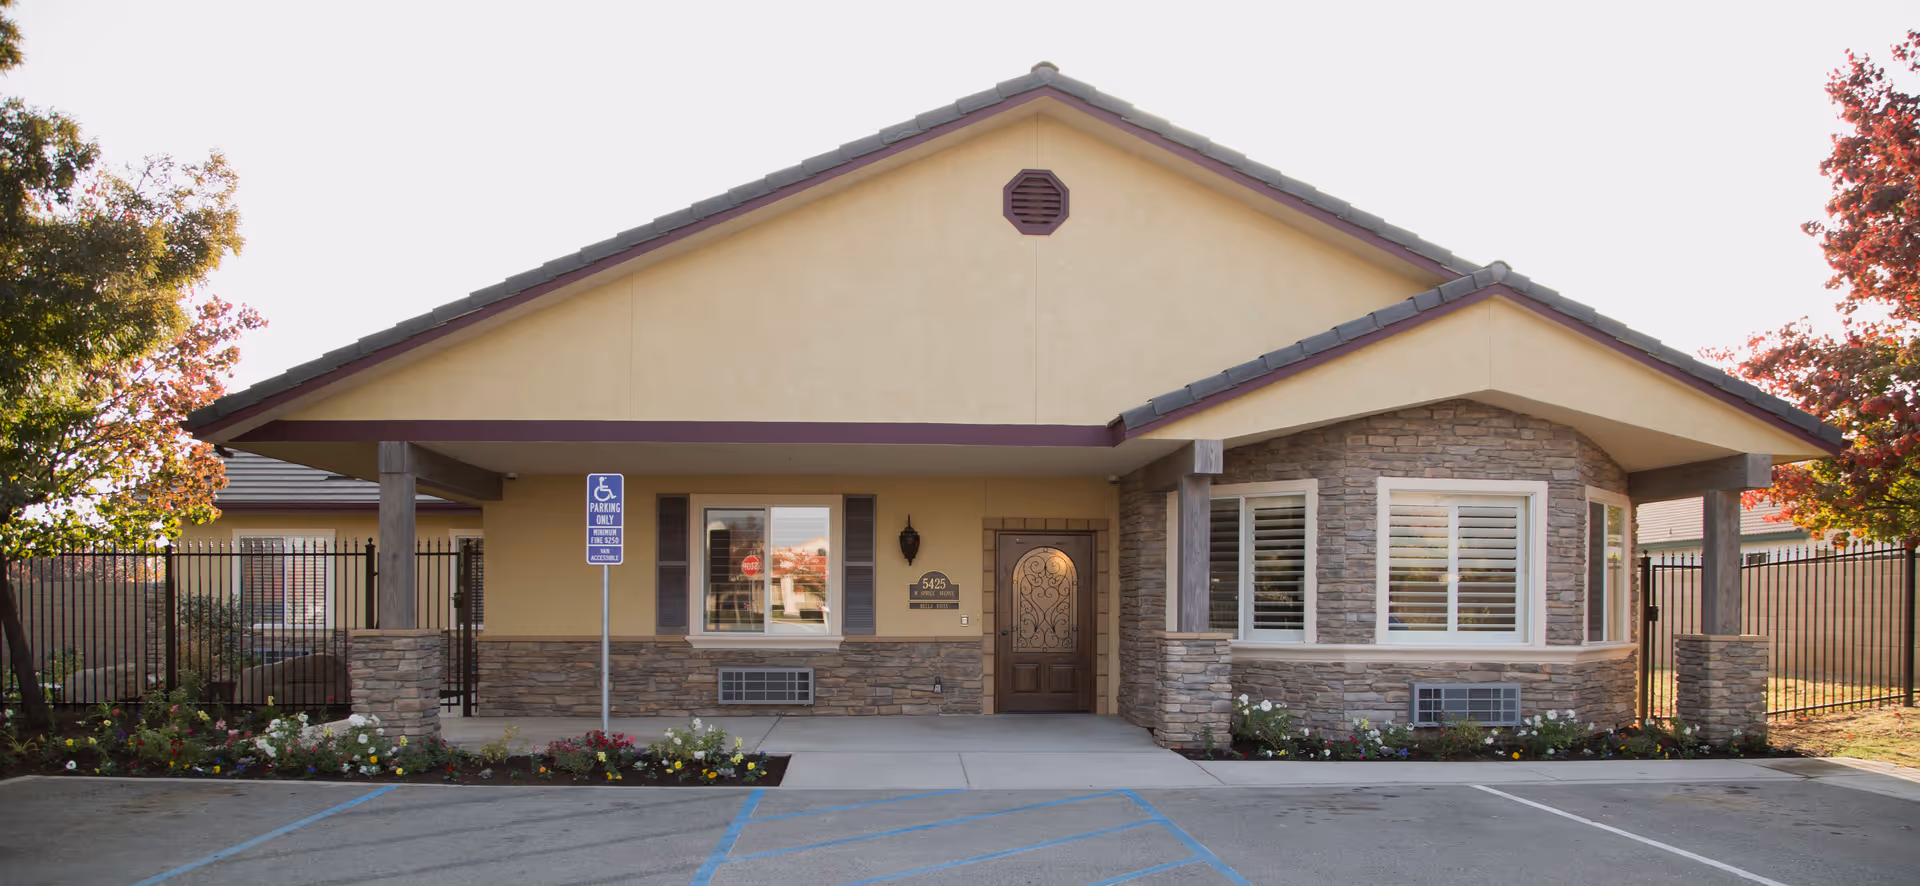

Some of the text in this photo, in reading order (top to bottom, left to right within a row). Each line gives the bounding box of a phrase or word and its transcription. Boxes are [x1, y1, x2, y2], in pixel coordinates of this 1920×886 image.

[590, 502, 620, 513] PARKING
[596, 514, 614, 525] ONLY
[922, 578, 946, 589] 5425
